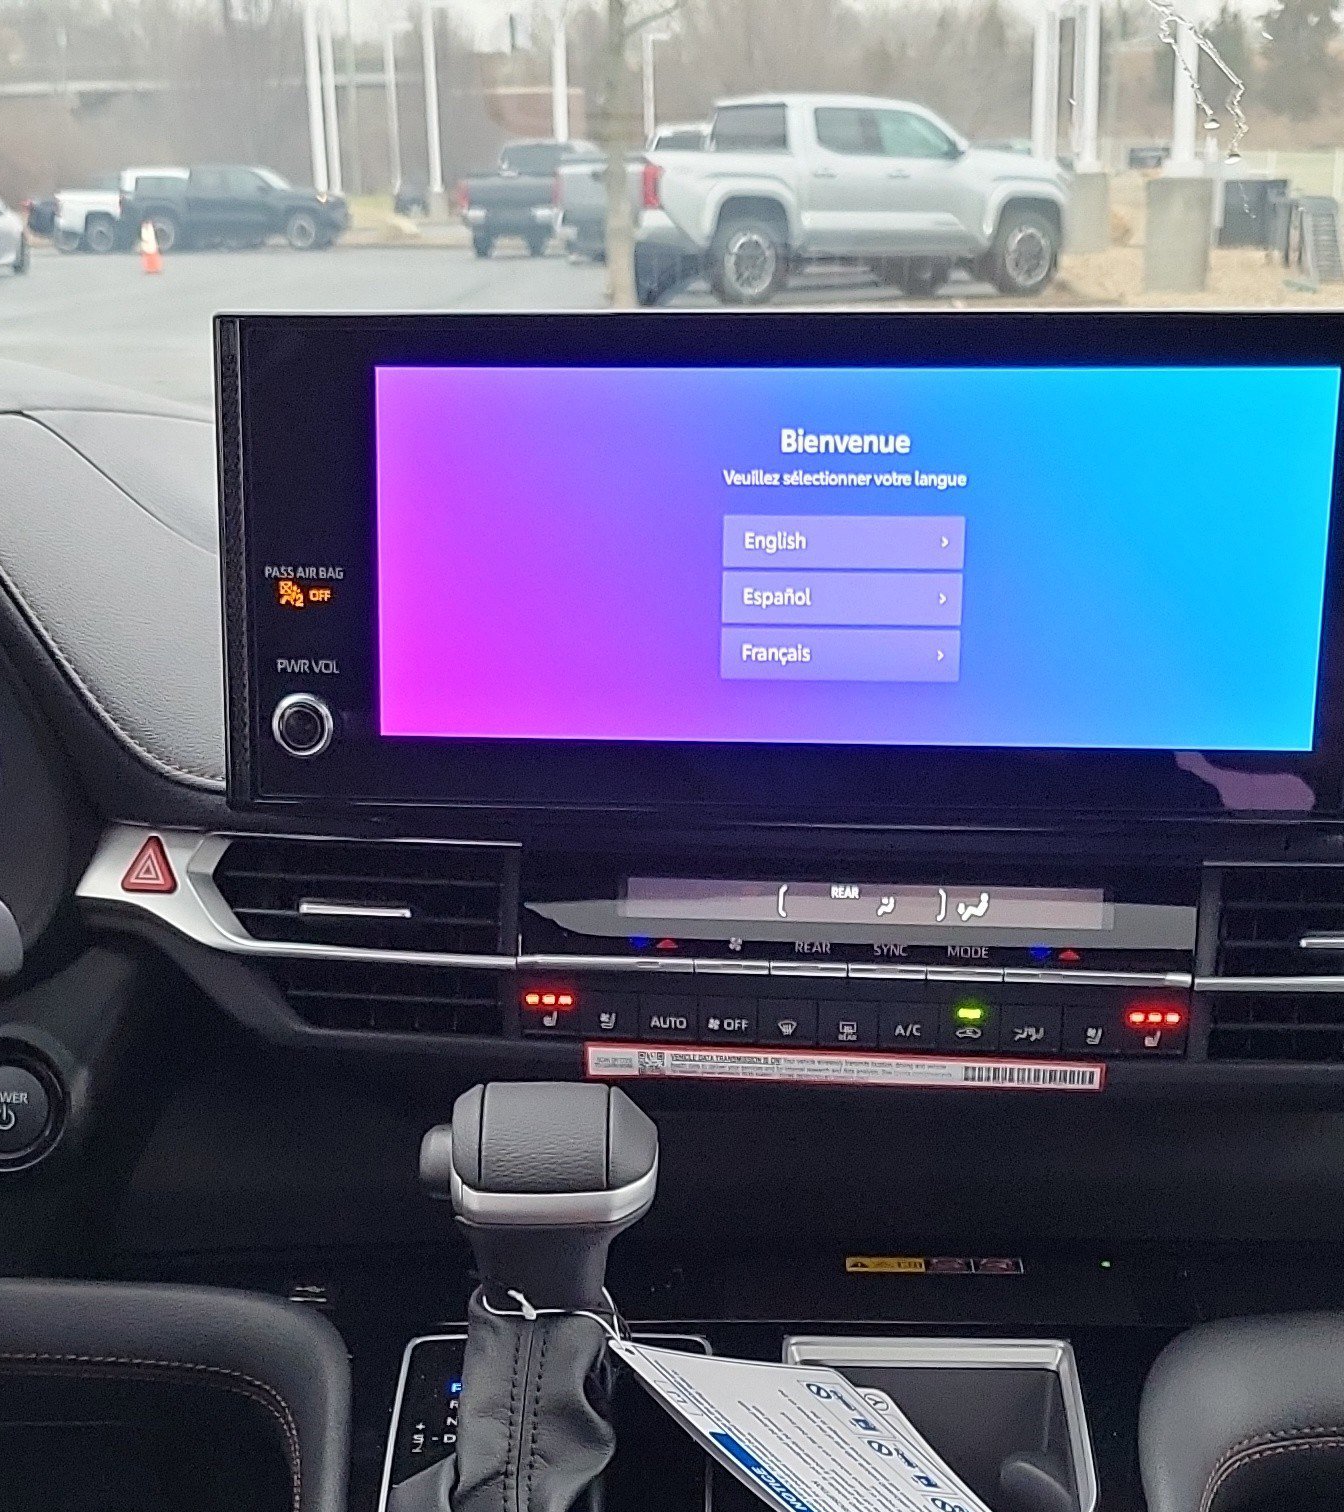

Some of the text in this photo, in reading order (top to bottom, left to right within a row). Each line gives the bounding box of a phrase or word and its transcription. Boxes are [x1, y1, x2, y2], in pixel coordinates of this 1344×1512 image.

[780, 429, 911, 454] Bienvenue
[722, 469, 968, 491] Veuillez sélectionner votre langue
[744, 531, 807, 555] English
[264, 566, 344, 581] PASS AIR BAG
[309, 589, 332, 603] OFF
[743, 586, 812, 610] Español
[741, 643, 811, 666] Français
[276, 659, 340, 675] PWR VOL
[830, 885, 860, 899] REAR
[794, 941, 831, 955] REAR
[873, 943, 908, 957] SYNC
[947, 945, 990, 959] MODE
[650, 1016, 687, 1030] AUTO
[723, 1018, 749, 1032] OFF
[894, 1024, 922, 1037] A/C
[749, 1464, 809, 1512] NOTICE
